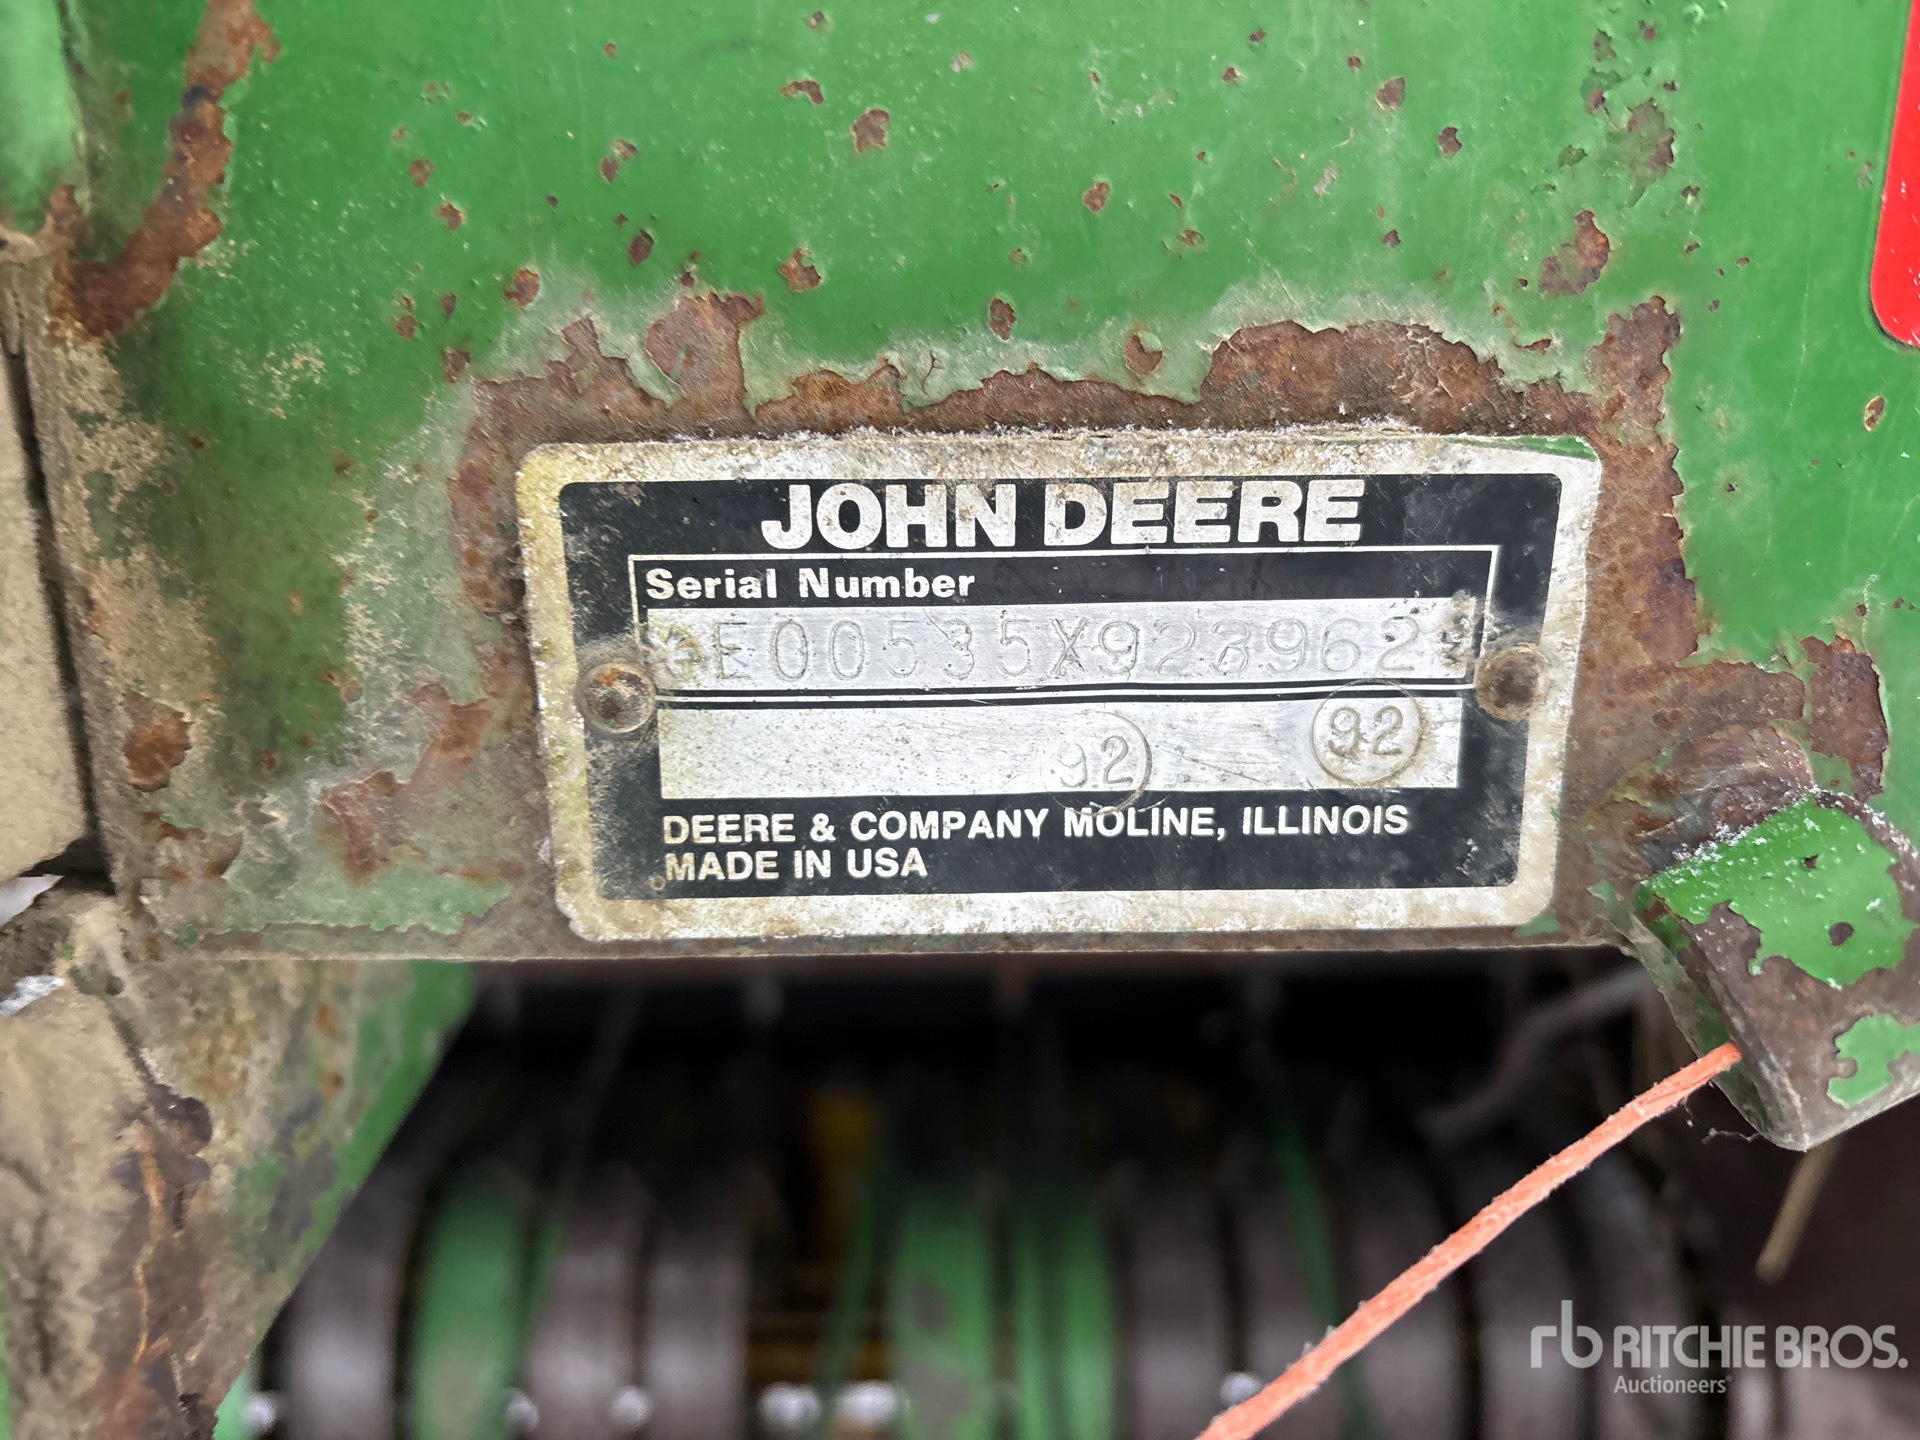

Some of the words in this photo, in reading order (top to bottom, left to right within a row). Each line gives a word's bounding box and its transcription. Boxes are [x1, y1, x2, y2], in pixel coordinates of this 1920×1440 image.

[761, 483, 1016, 549] JOHN
[1043, 479, 1365, 547] DEERE
[646, 568, 777, 600] Serial
[799, 567, 975, 600] Number
[1327, 705, 1405, 760] 92
[1050, 735, 1134, 789] 92
[663, 813, 796, 845] DEERE
[810, 812, 836, 842] &
[851, 807, 1050, 841] COMPANY
[1063, 806, 1226, 841] MOLINE,
[1242, 804, 1409, 837] ILLINOIS
[665, 850, 780, 882] MADE
[794, 849, 832, 880] IN
[847, 847, 928, 879] USA
